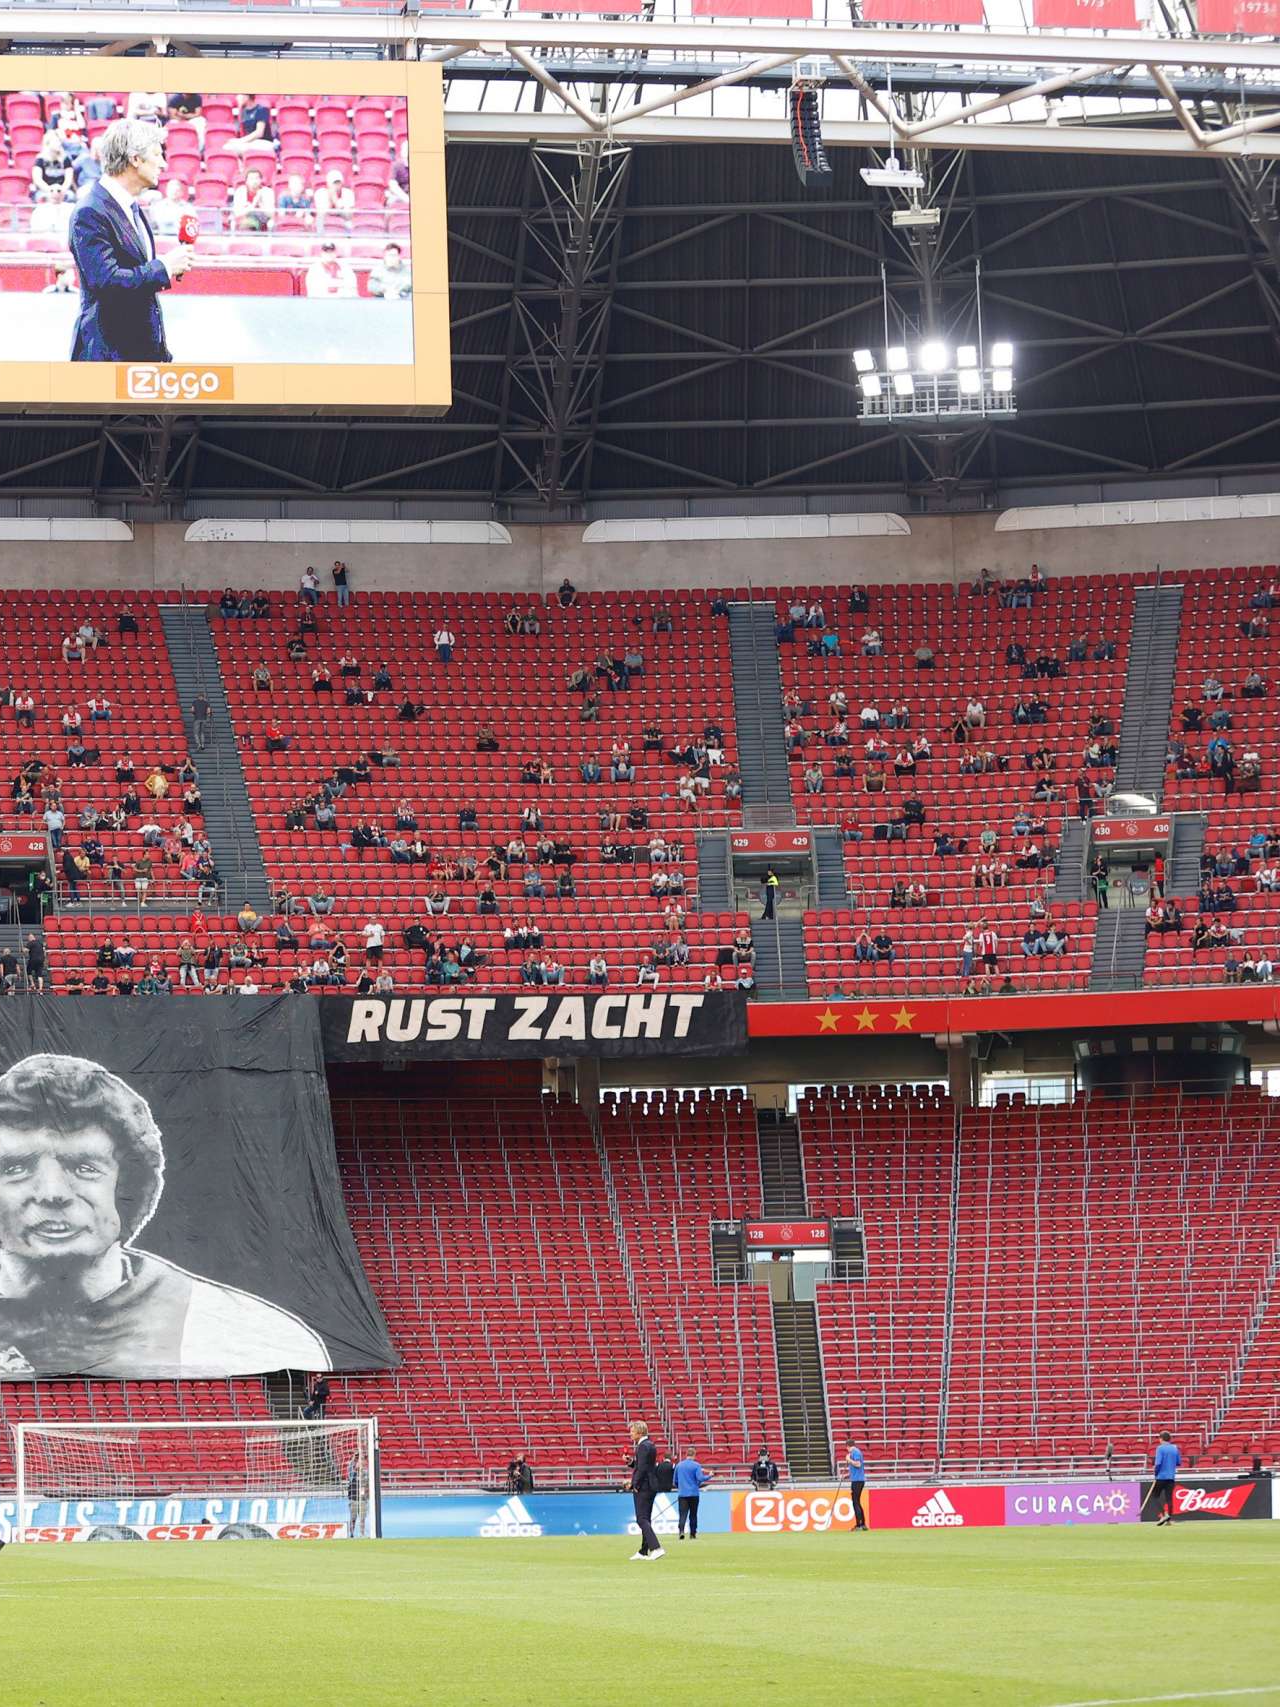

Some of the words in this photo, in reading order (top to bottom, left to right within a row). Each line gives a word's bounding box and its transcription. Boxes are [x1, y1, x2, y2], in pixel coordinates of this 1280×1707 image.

[1094, 827, 1111, 836] 430
[1153, 824, 1169, 833] 430
[28, 842, 44, 851] 428
[733, 838, 749, 847] 429
[792, 837, 808, 846] 429
[346, 996, 496, 1044] RUST
[508, 994, 704, 1042] ZACHT
[749, 1230, 764, 1239] 128
[810, 1228, 826, 1238] 128
[1175, 1488, 1233, 1512] Bud
[911, 1512, 964, 1527] adidas
[16, 1528, 82, 1543] CST
[147, 1526, 213, 1540] CST
[277, 1524, 344, 1539] CST
[479, 1522, 542, 1538] adidas
